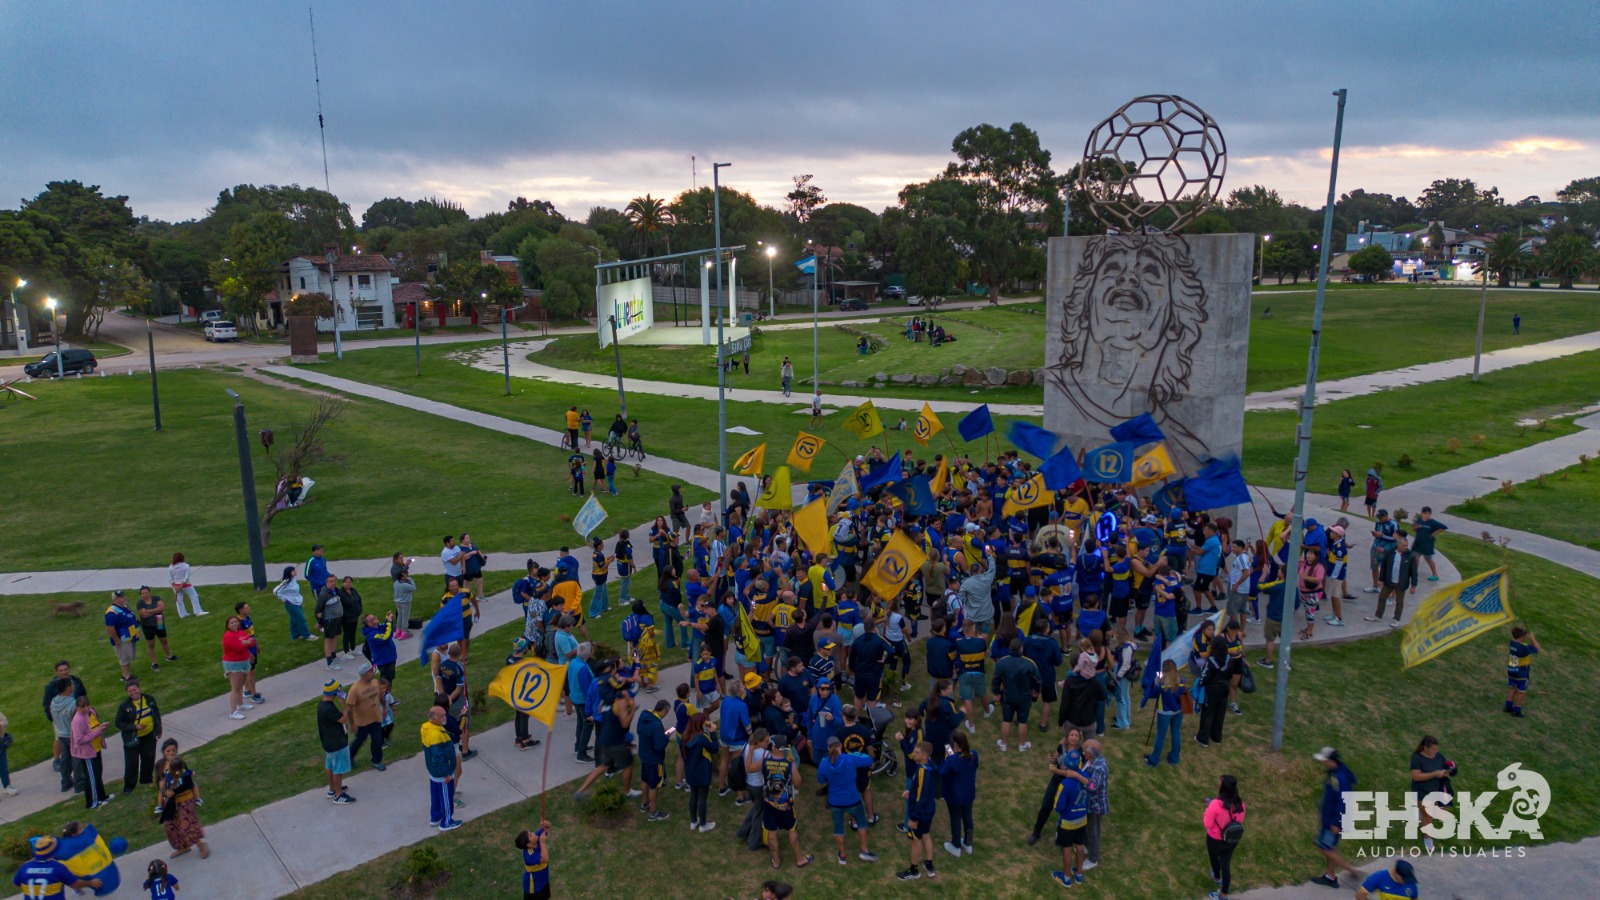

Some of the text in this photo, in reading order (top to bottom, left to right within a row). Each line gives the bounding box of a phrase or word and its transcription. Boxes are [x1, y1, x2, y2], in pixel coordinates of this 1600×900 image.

[799, 440, 816, 455] 12
[1100, 454, 1118, 473] 12
[1016, 483, 1034, 501] 12
[779, 612, 789, 628] 10
[518, 671, 542, 704] 12
[28, 878, 49, 900] 17
